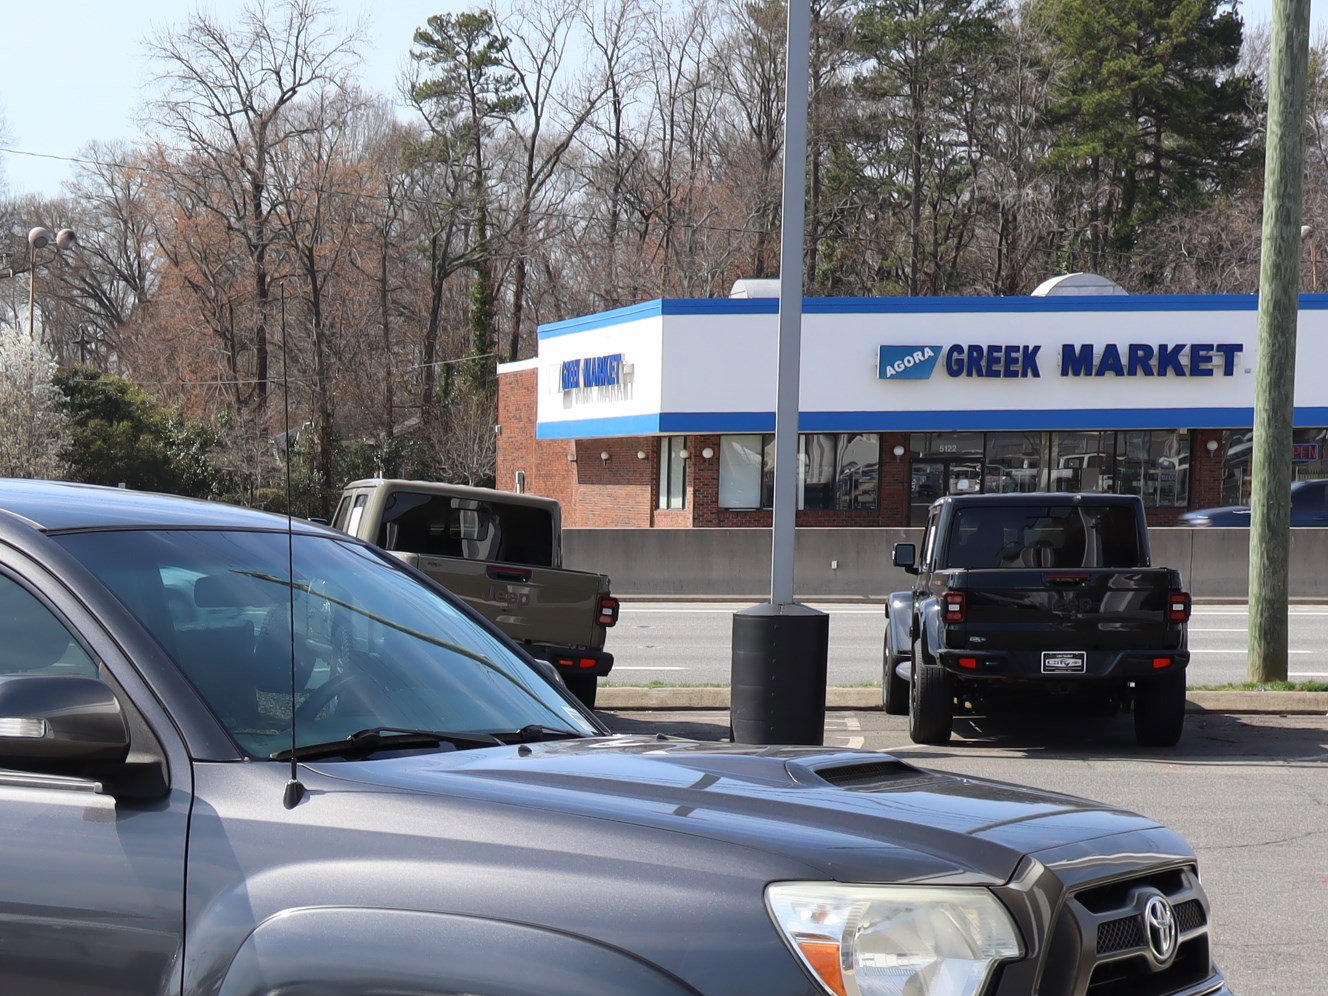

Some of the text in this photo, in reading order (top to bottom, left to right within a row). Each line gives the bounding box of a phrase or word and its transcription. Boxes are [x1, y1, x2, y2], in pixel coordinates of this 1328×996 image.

[583, 353, 622, 388] MARKET
[886, 343, 1244, 378] AGORA GREEK MARKET
[939, 444, 957, 453] 5122
[1293, 446, 1317, 459] PEN
